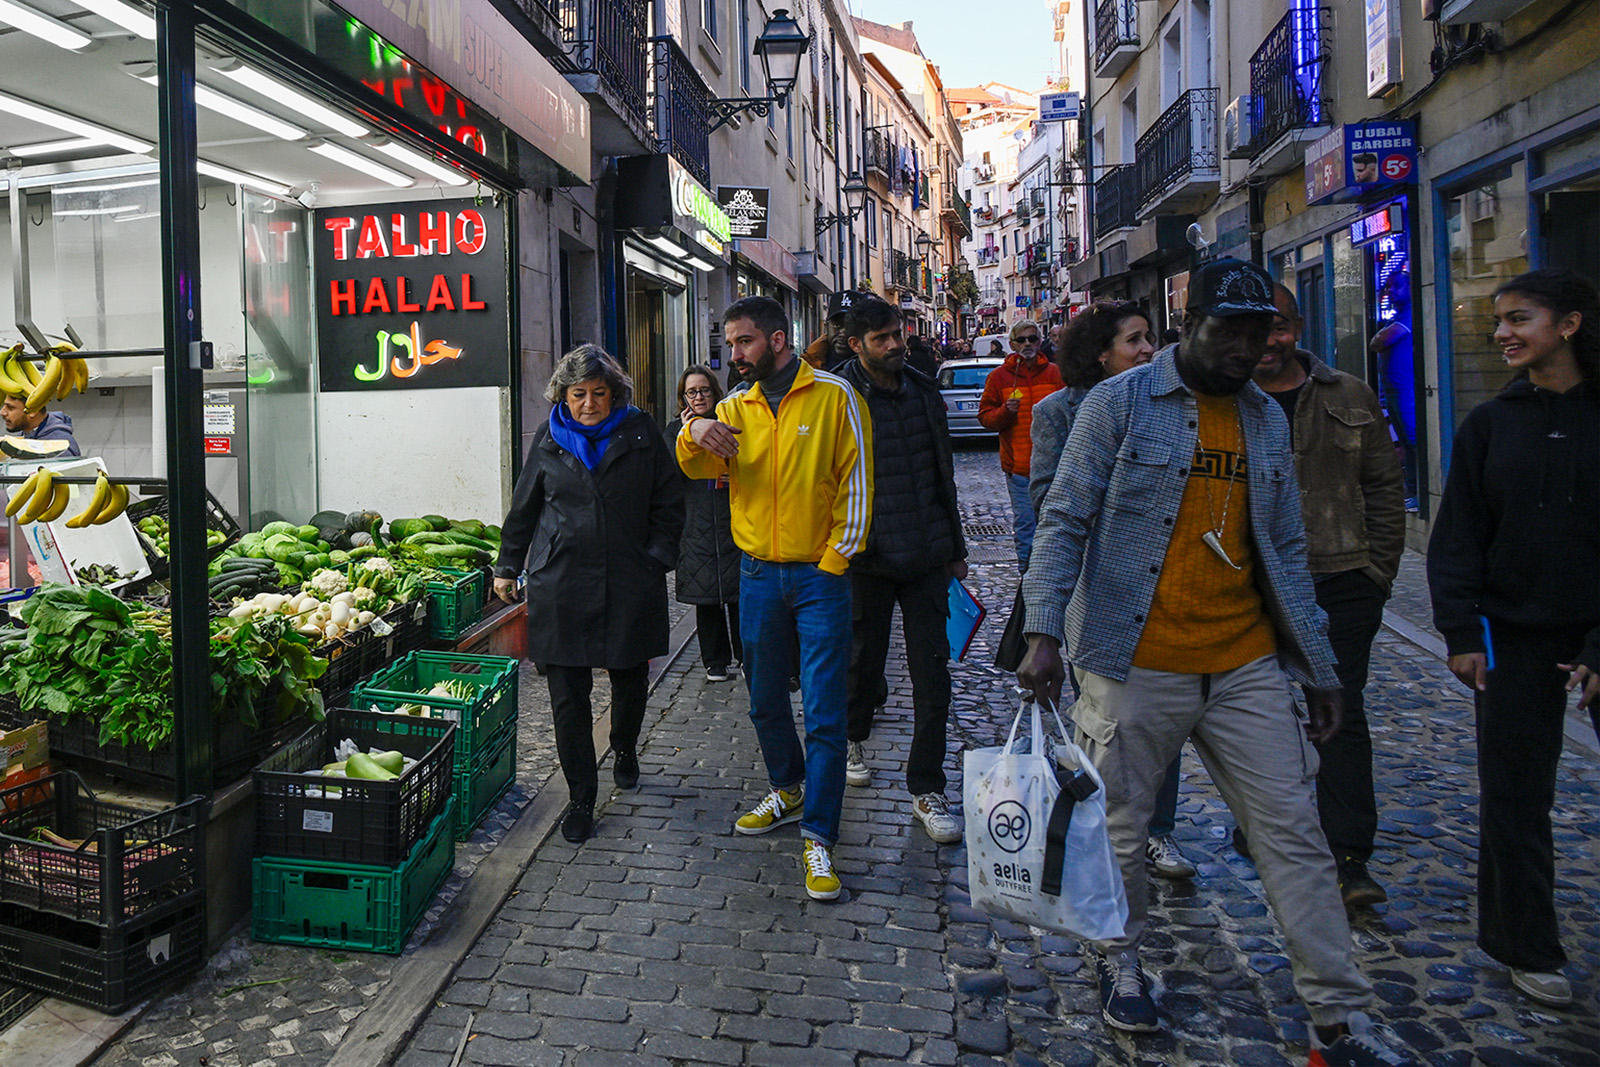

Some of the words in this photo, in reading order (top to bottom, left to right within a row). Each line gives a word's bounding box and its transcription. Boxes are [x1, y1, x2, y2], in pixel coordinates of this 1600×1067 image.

[1354, 127, 1402, 139] DUBAI
[1351, 138, 1412, 150] BARBER
[1385, 159, 1408, 176] 5€
[325, 209, 487, 260] TALHO
[330, 273, 486, 316] HALAL
[841, 293, 852, 306] LA
[354, 320, 463, 381] حلال
[993, 862, 1031, 884] aelia
